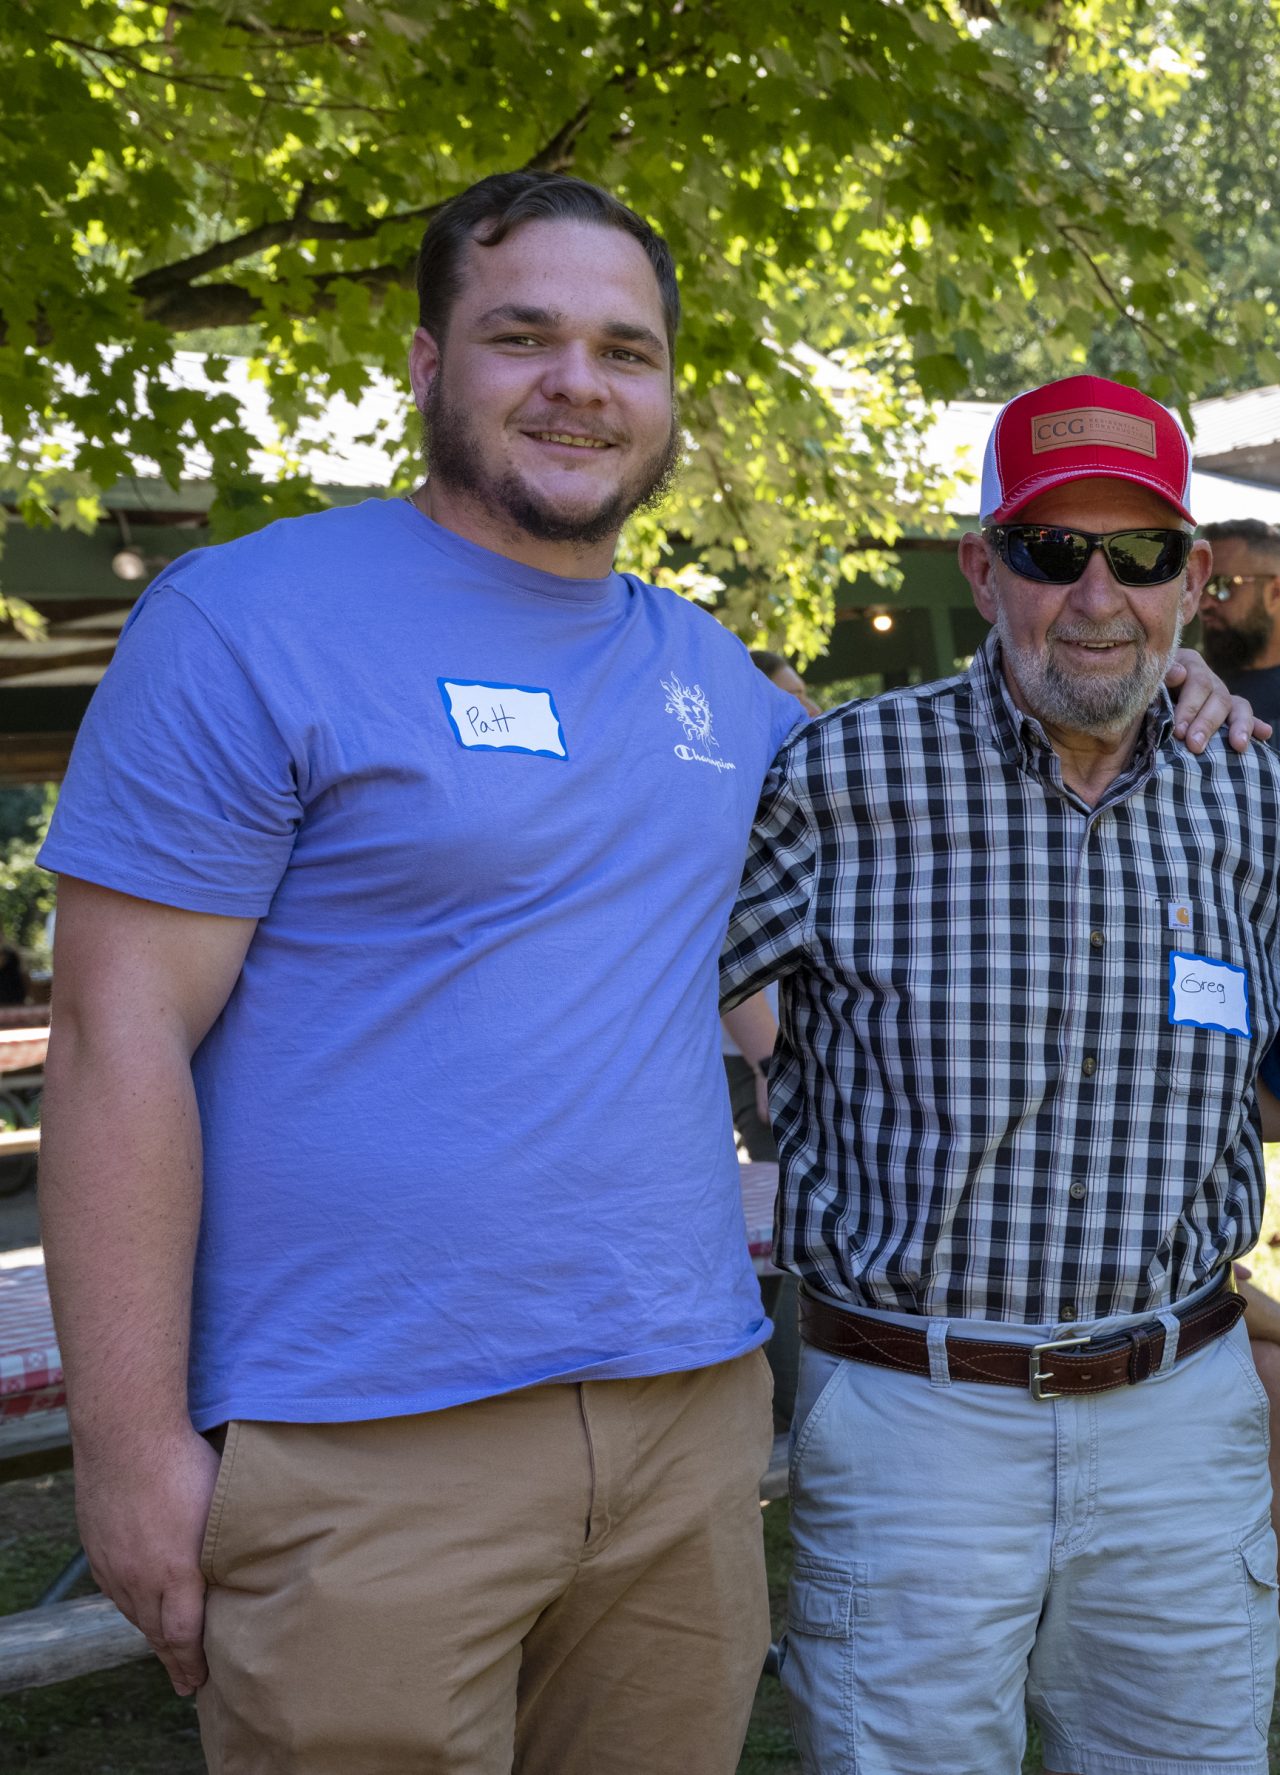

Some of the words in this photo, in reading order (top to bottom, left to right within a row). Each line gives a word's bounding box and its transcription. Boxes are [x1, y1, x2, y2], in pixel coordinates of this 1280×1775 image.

[1038, 418, 1084, 440] CCG
[674, 744, 736, 773] Champion
[1180, 972, 1226, 1004] Greg
